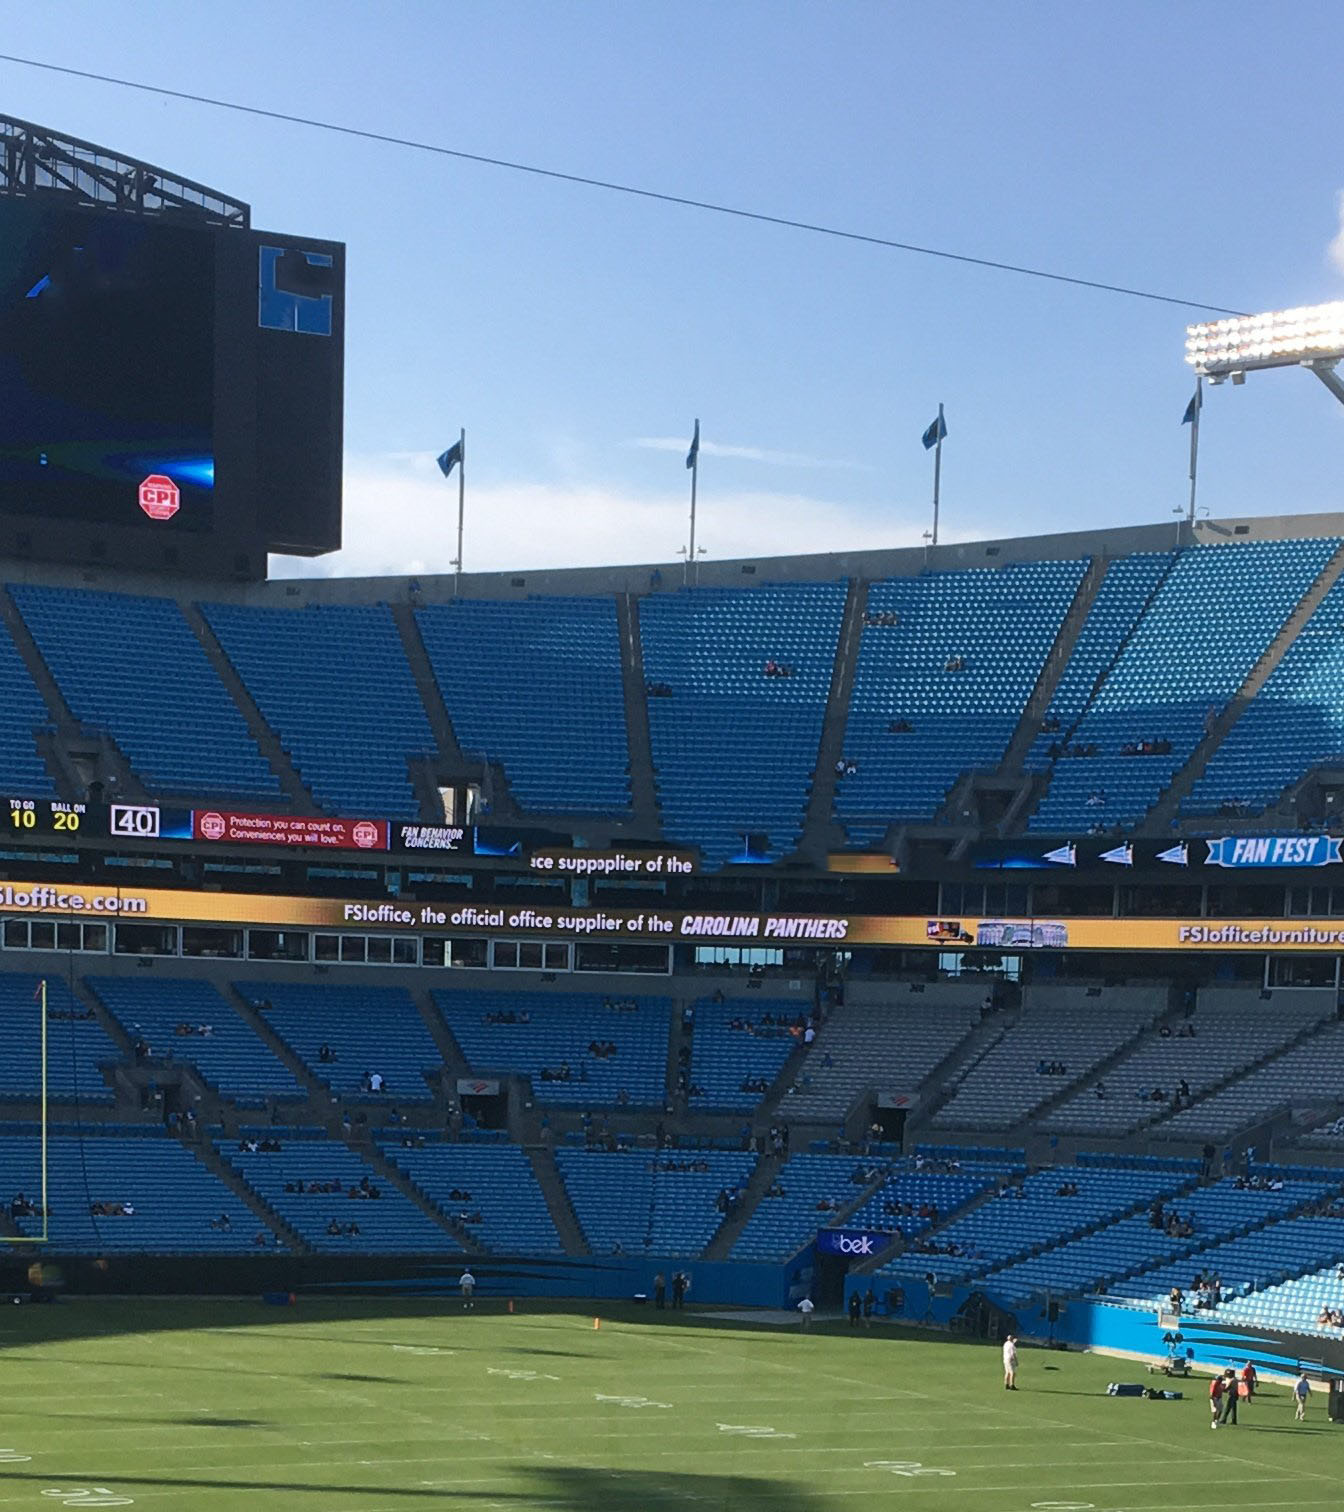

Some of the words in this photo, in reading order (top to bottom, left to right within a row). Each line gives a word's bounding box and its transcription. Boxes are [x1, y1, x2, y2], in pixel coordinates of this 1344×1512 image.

[143, 489, 176, 505] CPI
[9, 799, 22, 810] TO
[22, 800, 35, 811] GO
[50, 802, 72, 813] BALL
[73, 804, 86, 814] ON
[10, 810, 36, 828] 10
[53, 812, 80, 831] 20
[118, 810, 154, 834] 40
[202, 820, 223, 832] CPI
[230, 816, 272, 830] Protection
[273, 820, 288, 832] you
[289, 821, 306, 831] can
[307, 821, 329, 832] count
[330, 823, 345, 833] on.
[230, 828, 286, 842] Conveniences
[287, 831, 304, 844] you
[304, 831, 319, 843] will
[355, 829, 377, 841] CPI
[400, 825, 419, 838] FAN
[420, 826, 463, 841] BEHAVIOR
[1231, 838, 1270, 864] FAN
[1272, 836, 1320, 864] FEST
[645, 855, 663, 873] of
[667, 856, 693, 874] the
[344, 904, 416, 926] FSIoffice,
[420, 906, 446, 924] the
[450, 907, 505, 927] official
[509, 909, 553, 928] office
[557, 912, 623, 933] supplier
[626, 913, 645, 932] of
[647, 914, 674, 933] the
[680, 916, 758, 937] CAROLINA
[763, 917, 849, 939] PANTHERS
